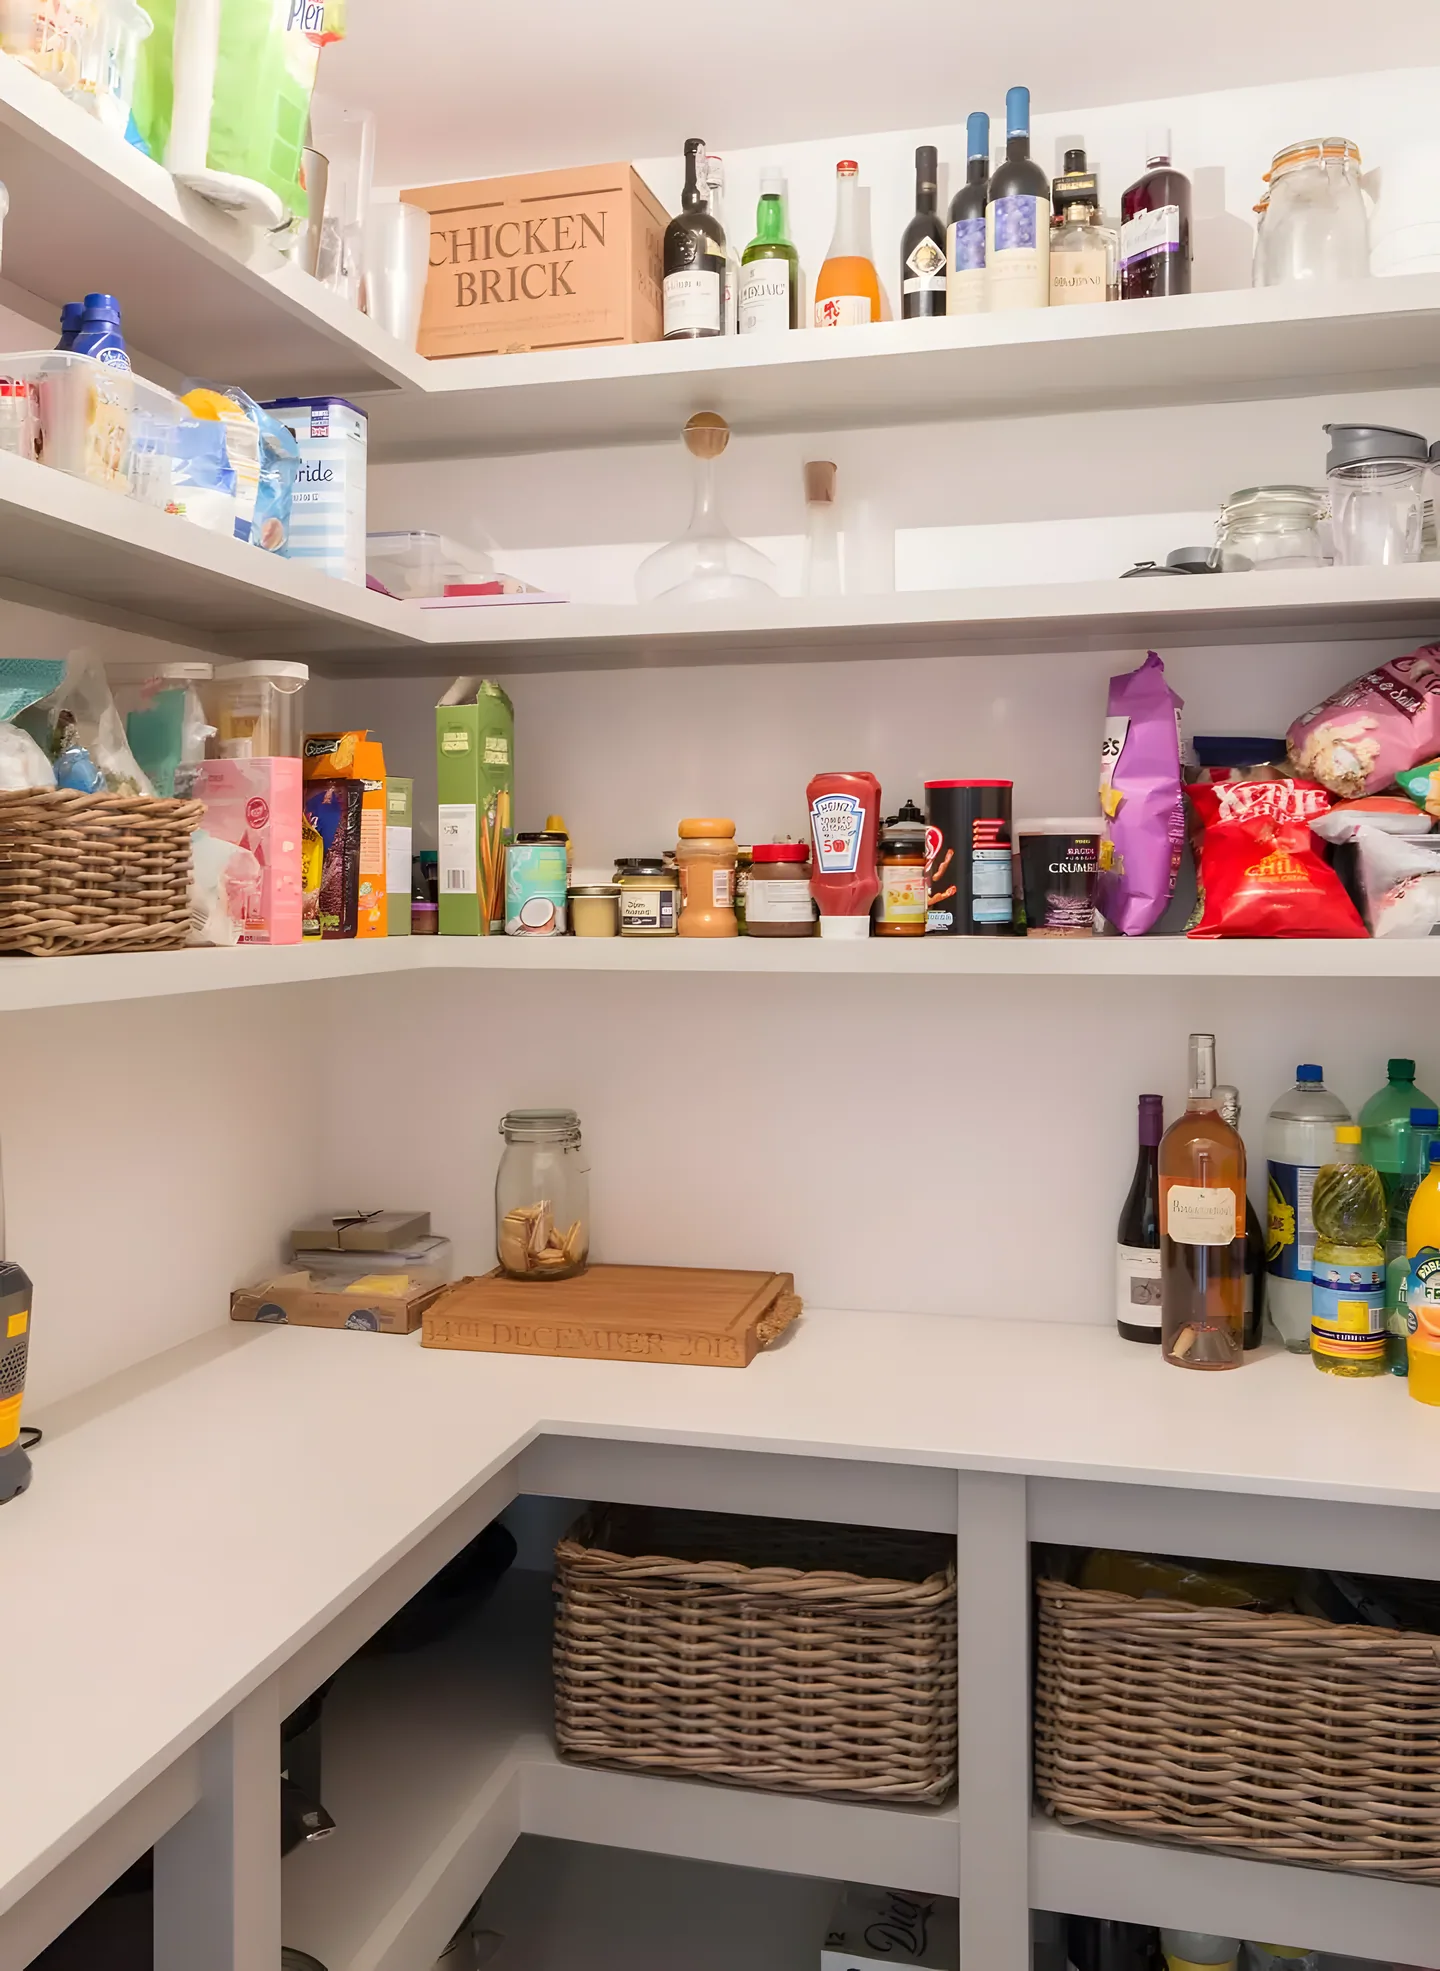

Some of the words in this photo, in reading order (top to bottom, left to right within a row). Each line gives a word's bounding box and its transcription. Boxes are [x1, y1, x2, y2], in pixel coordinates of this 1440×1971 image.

[429, 211, 608, 267] CHICKEN
[454, 260, 577, 308] BRICK
[492, 1323, 664, 1355] DECEMBER
[680, 1333, 740, 1361] 2013
